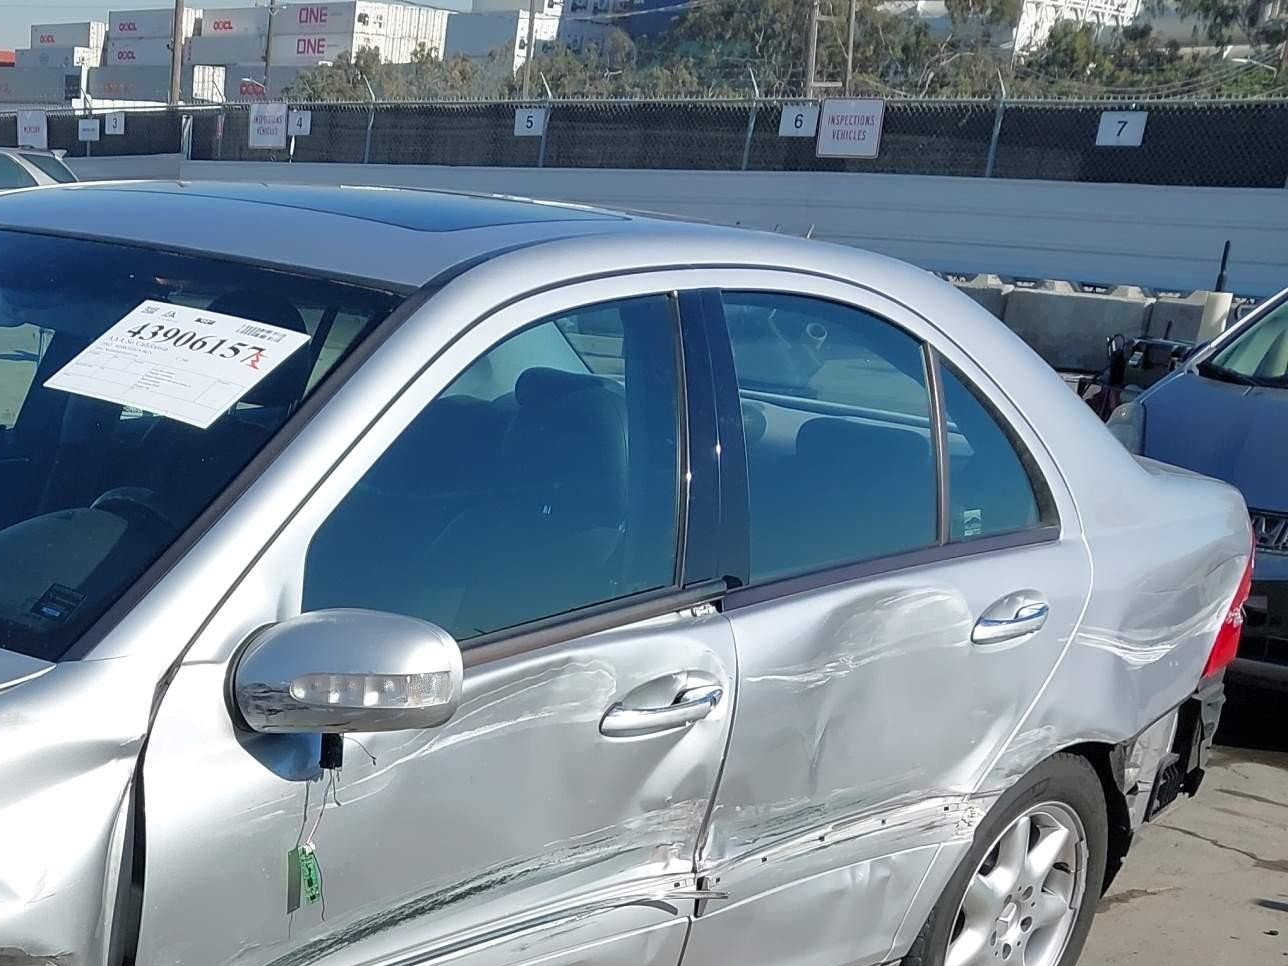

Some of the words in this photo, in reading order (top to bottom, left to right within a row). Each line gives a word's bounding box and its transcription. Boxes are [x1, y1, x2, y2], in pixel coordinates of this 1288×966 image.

[299, 7, 328, 24] ONE
[119, 23, 137, 31] OOCL
[213, 21, 233, 30] OOCL
[40, 35, 55, 43] OOCL
[296, 38, 325, 54] ONE
[117, 51, 136, 60] OOCL
[112, 118, 118, 129] 3
[296, 117, 303, 129] 4
[526, 115, 534, 129] 5
[794, 113, 804, 129] 6
[828, 115, 875, 126] INSPECTIONS
[1117, 120, 1129, 136] 7
[832, 129, 866, 140] VEHICLES
[127, 321, 266, 362] 43906157
